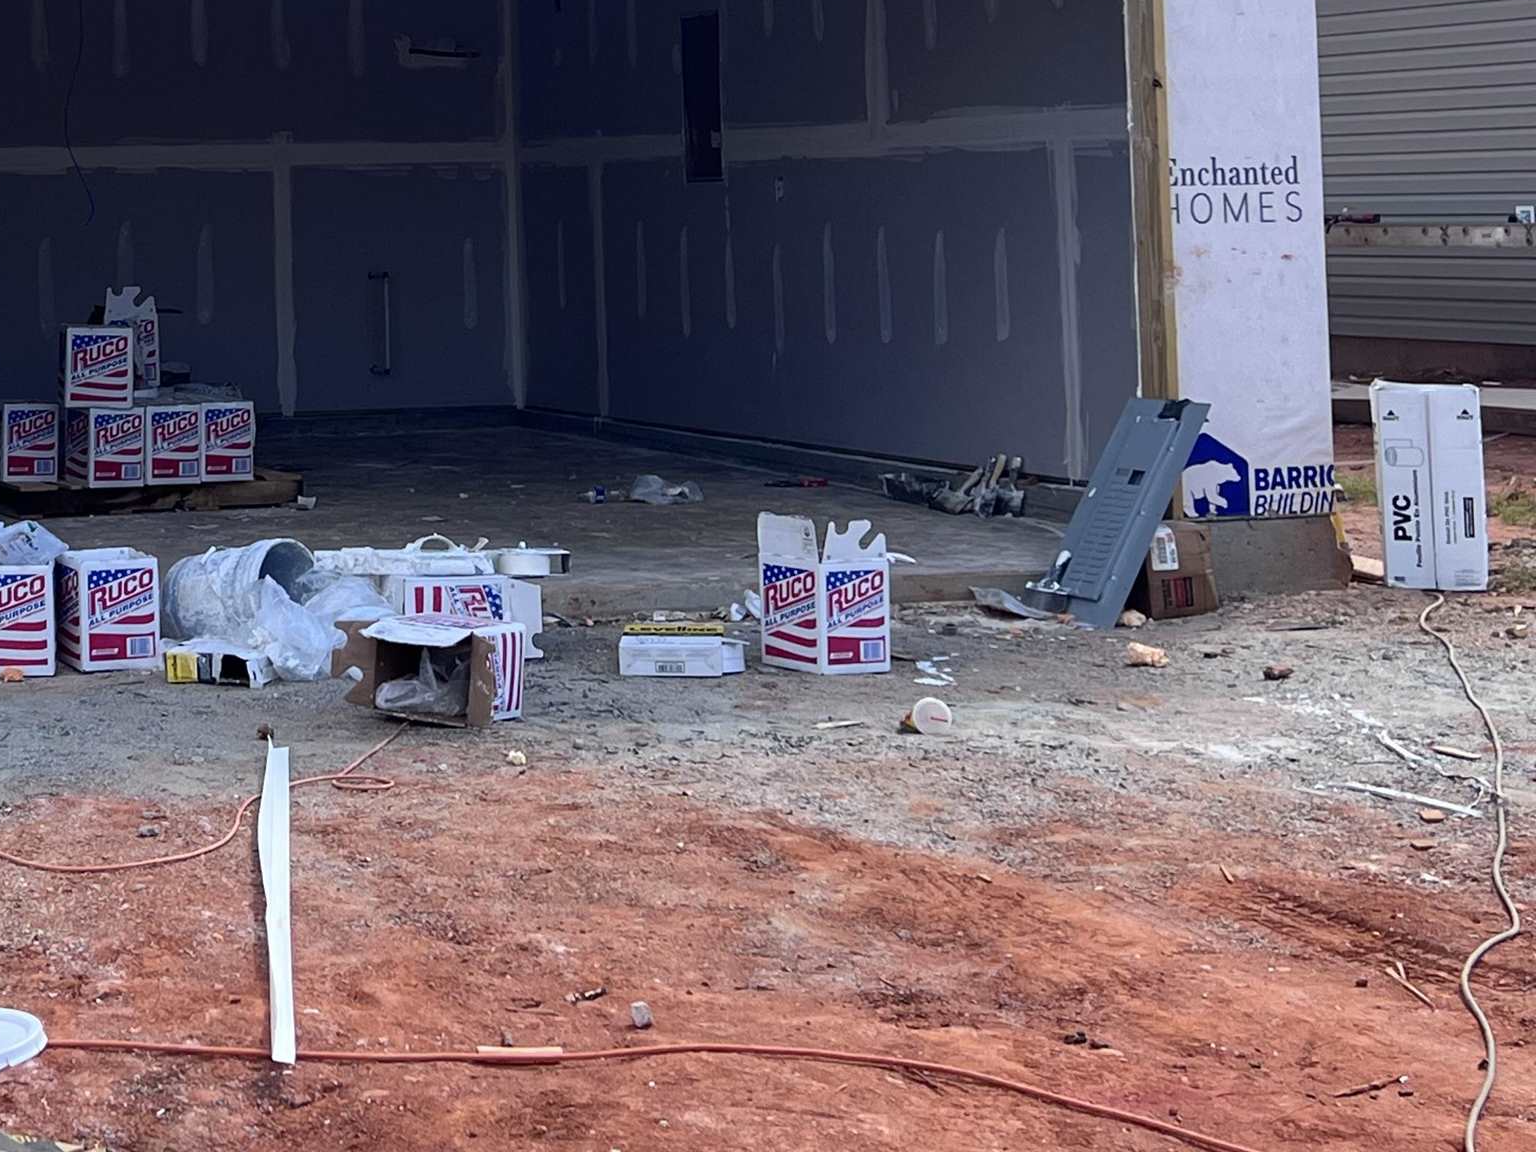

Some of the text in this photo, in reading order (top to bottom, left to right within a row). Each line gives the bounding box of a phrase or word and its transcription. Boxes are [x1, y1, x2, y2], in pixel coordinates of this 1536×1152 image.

[72, 335, 129, 373] RUCO
[88, 357, 128, 376] PURPOSE
[8, 409, 55, 444] RUCO
[95, 414, 142, 449] RUCO
[153, 411, 199, 447] RUCO
[206, 408, 251, 444] RUCO
[1254, 465, 1335, 491] BARRIC
[1255, 491, 1335, 516] BUILDIN
[1392, 495, 1414, 542] PVC
[89, 568, 154, 619] RUCO
[89, 594, 153, 626] ALL PURPOSE
[765, 571, 815, 616] RUCO
[828, 570, 884, 619] RUCO
[765, 601, 815, 627] ALL PURPOSE
[827, 597, 884, 628] ALL PURPOSE
